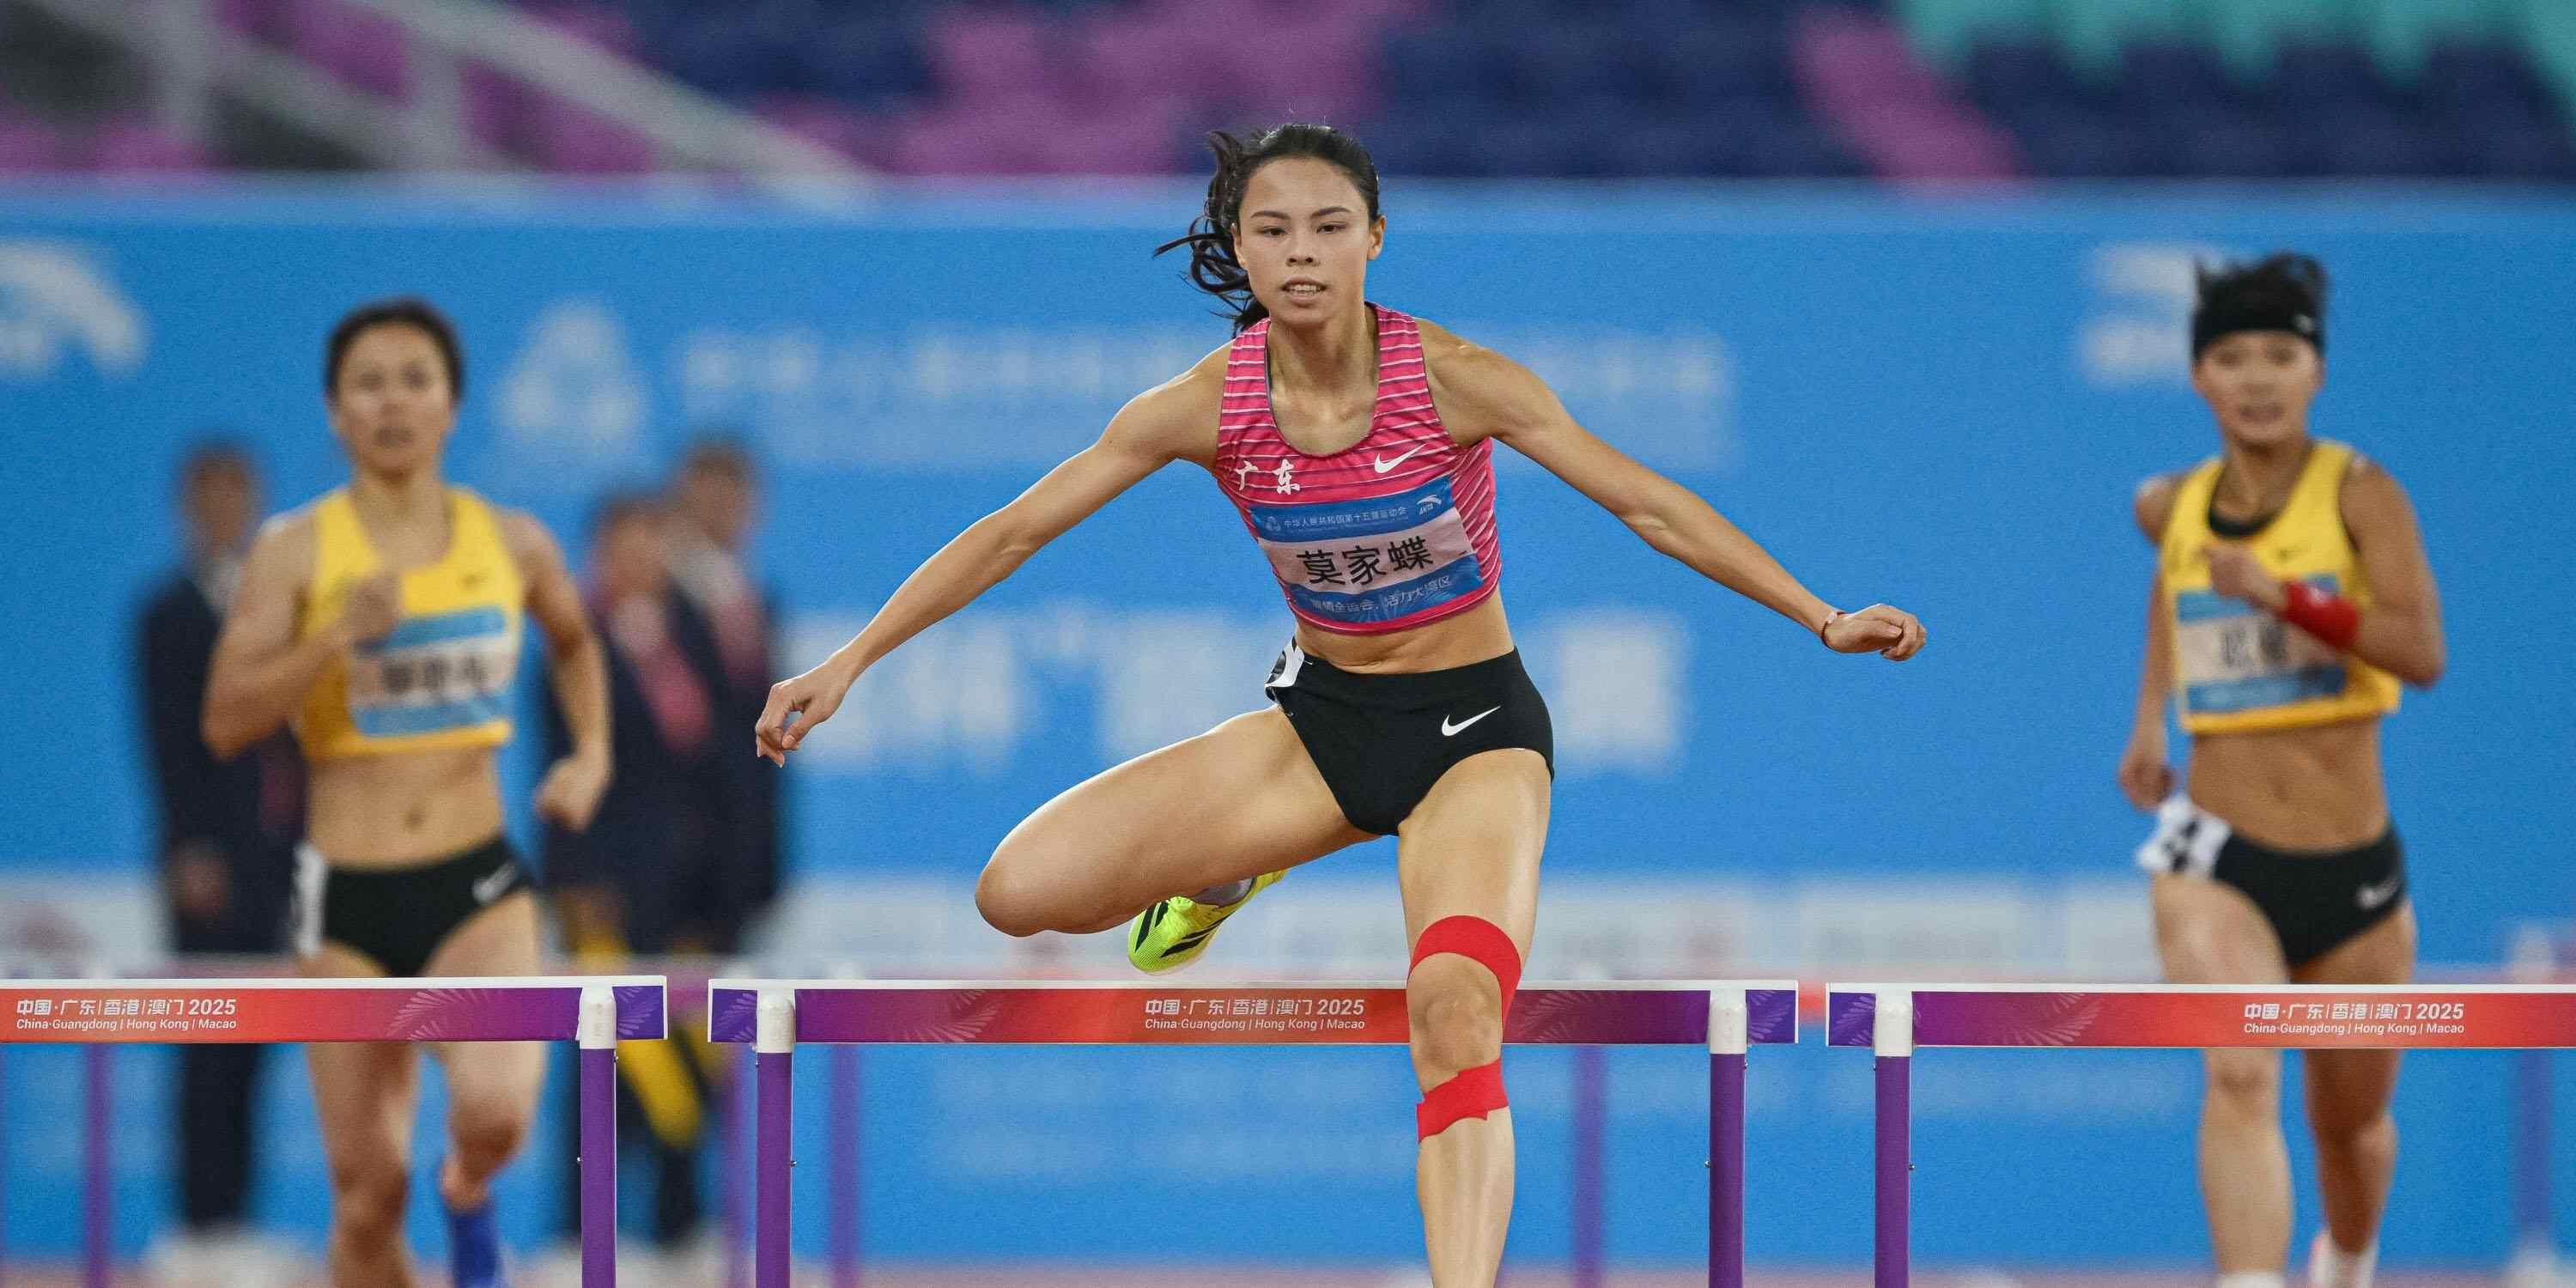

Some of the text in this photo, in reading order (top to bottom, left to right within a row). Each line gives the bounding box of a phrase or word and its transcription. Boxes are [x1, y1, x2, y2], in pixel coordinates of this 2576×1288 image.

[1234, 459, 1300, 495] 广东
[1297, 535, 1433, 586] 莫家蝶
[189, 999, 237, 1015] 2025
[1317, 999, 1365, 1015] 2025
[2416, 1003, 2464, 1020] 2025
[127, 1018, 157, 1030] Hong
[160, 1018, 189, 1030] Kong
[198, 1018, 236, 1029] Macao
[1255, 1018, 1285, 1030] Hong
[1288, 1018, 1317, 1030] Kong
[1327, 1018, 1365, 1029] Macao
[2354, 1023, 2385, 1036] Hong
[2387, 1023, 2417, 1036] Kong
[2427, 1023, 2464, 1034] Macao
